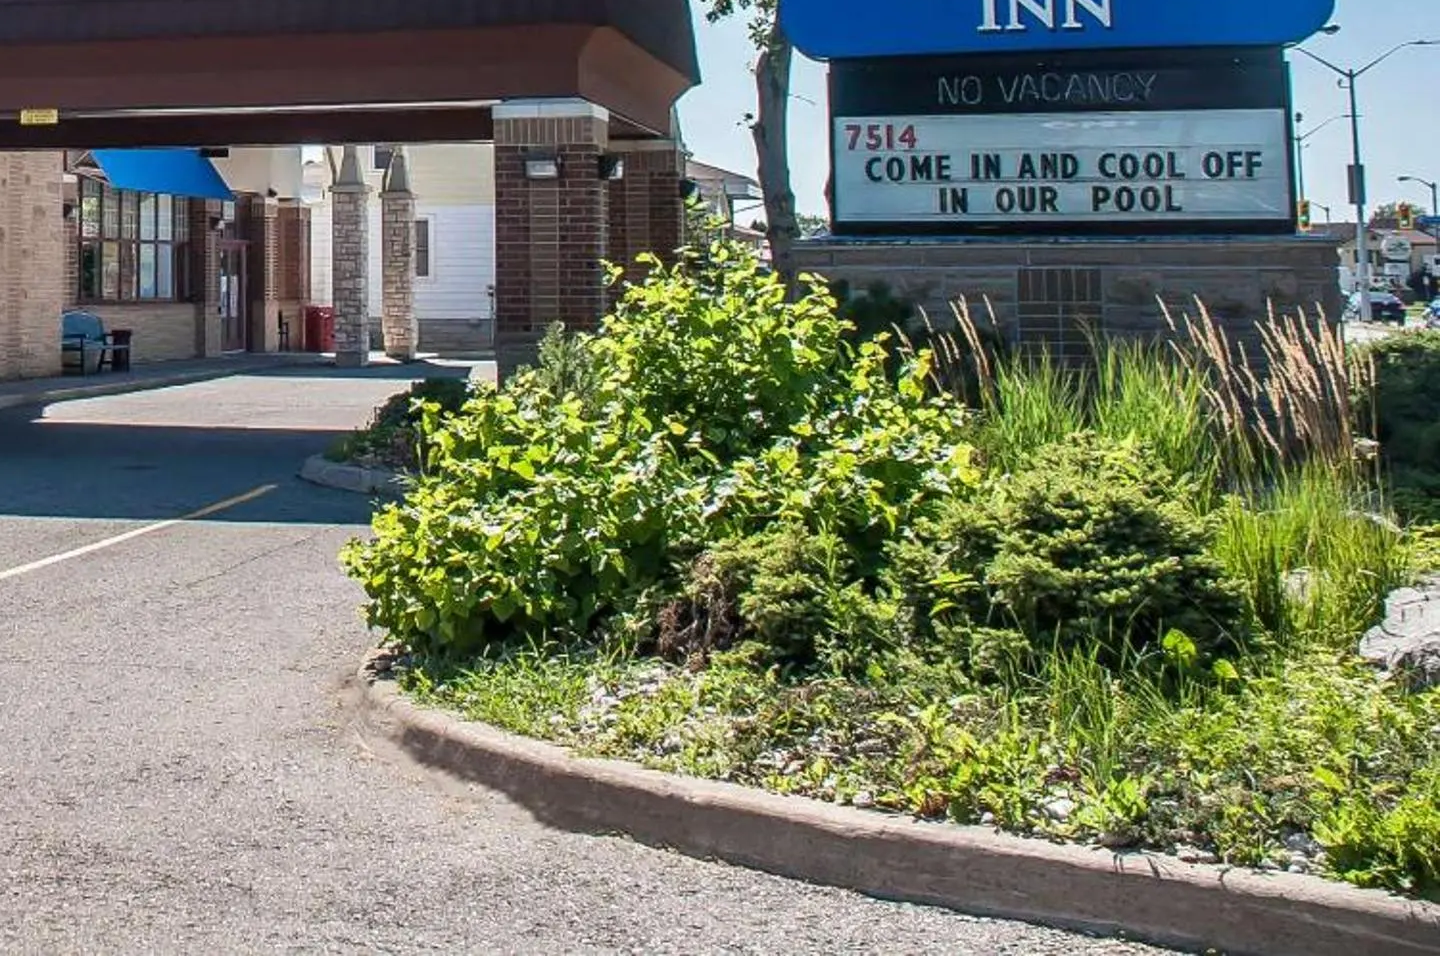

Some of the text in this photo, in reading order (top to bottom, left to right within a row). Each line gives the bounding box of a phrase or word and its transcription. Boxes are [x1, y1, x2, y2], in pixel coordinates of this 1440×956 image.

[937, 72, 1158, 106] NO VACANCY
[844, 123, 917, 150] 7514
[864, 151, 1263, 183] COME IN AND COOL OFF
[939, 185, 1182, 215] IN OUR POOL
